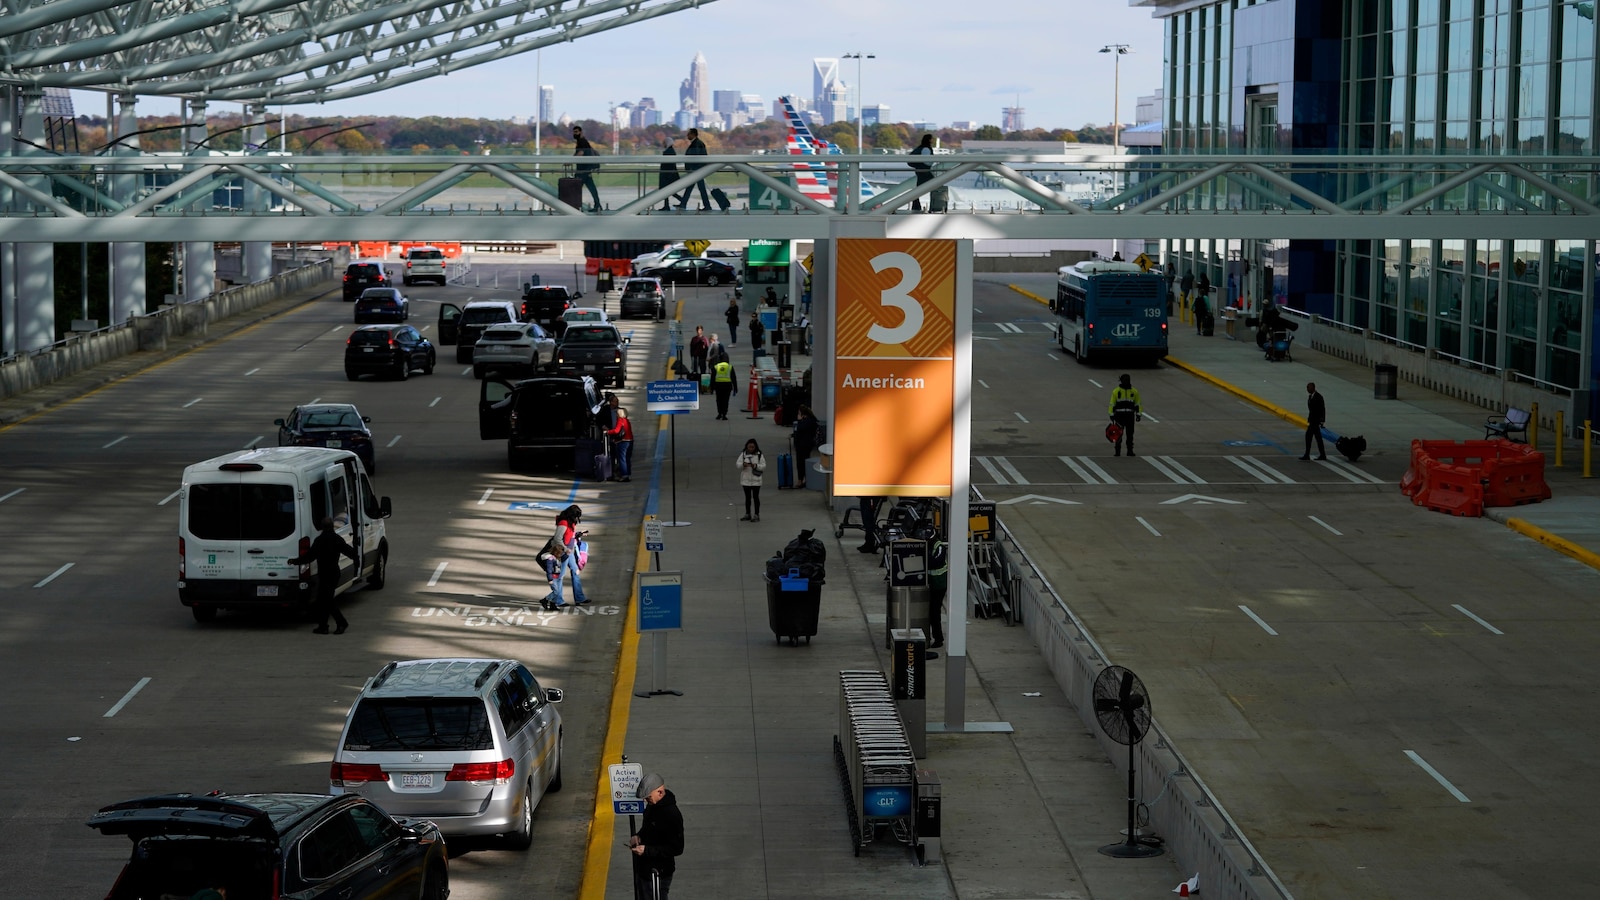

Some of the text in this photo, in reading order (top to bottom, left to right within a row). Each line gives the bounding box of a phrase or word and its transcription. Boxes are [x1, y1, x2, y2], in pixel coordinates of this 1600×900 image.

[758, 186, 781, 209] 4
[867, 252, 924, 344] 3
[1144, 308, 1161, 318] 139
[1116, 323, 1141, 337] CLT
[842, 374, 925, 389] American
[411, 605, 620, 617] UNLOADING
[464, 615, 557, 627] ONLY
[906, 642, 915, 697] smartecarte
[880, 798, 895, 806] CLT
